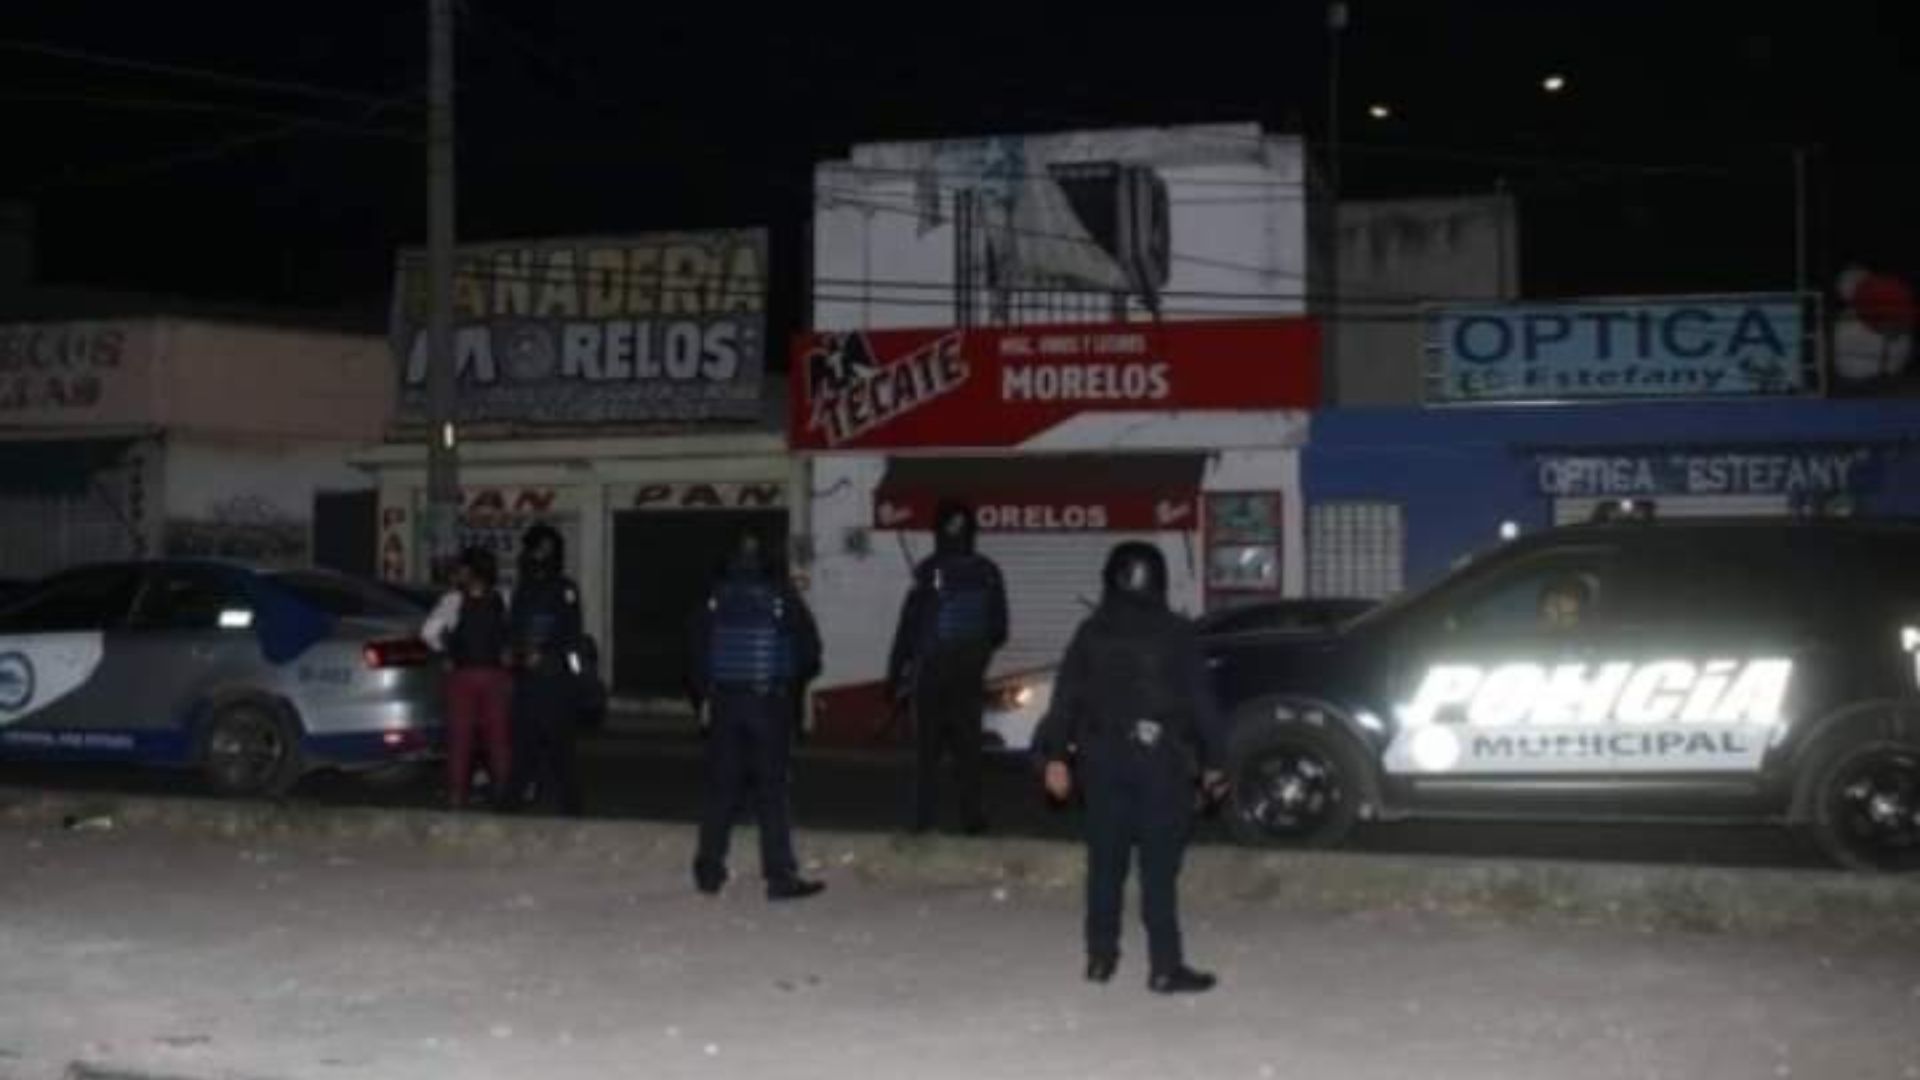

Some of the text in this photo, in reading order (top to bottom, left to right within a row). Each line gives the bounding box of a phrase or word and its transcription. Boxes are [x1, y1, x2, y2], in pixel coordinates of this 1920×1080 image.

[1454, 308, 1786, 366] OPTICA
[814, 332, 970, 443] TECATE
[1002, 362, 1170, 401] MORELOS
[1525, 361, 1724, 394] Estefany
[636, 485, 782, 507] PAN
[1471, 731, 1750, 760] MUNICIPAL
